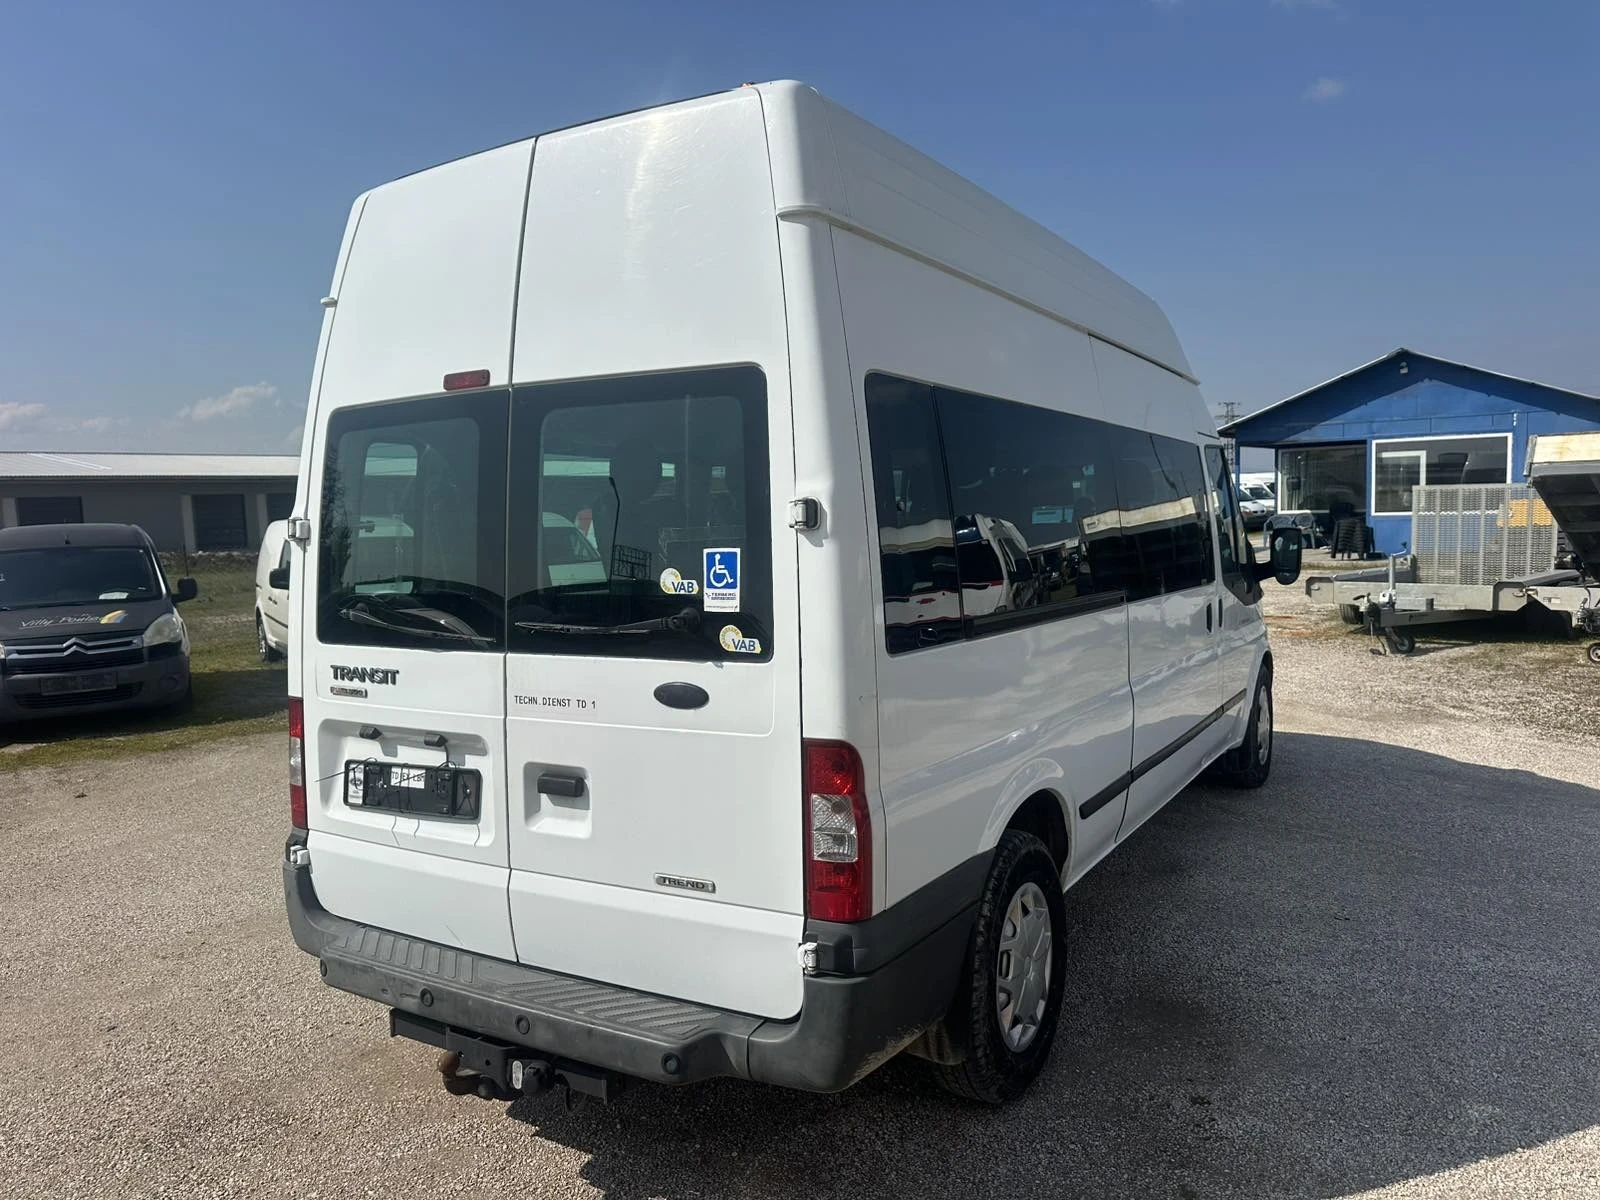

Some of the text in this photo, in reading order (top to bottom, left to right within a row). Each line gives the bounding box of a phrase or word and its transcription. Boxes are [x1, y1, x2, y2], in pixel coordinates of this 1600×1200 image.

[671, 581, 695, 593] VAB
[732, 638, 756, 651] VAB
[330, 664, 399, 685] TRANSIT
[576, 699, 587, 709] TD
[591, 700, 596, 709] 1
[659, 876, 705, 889] TREND
